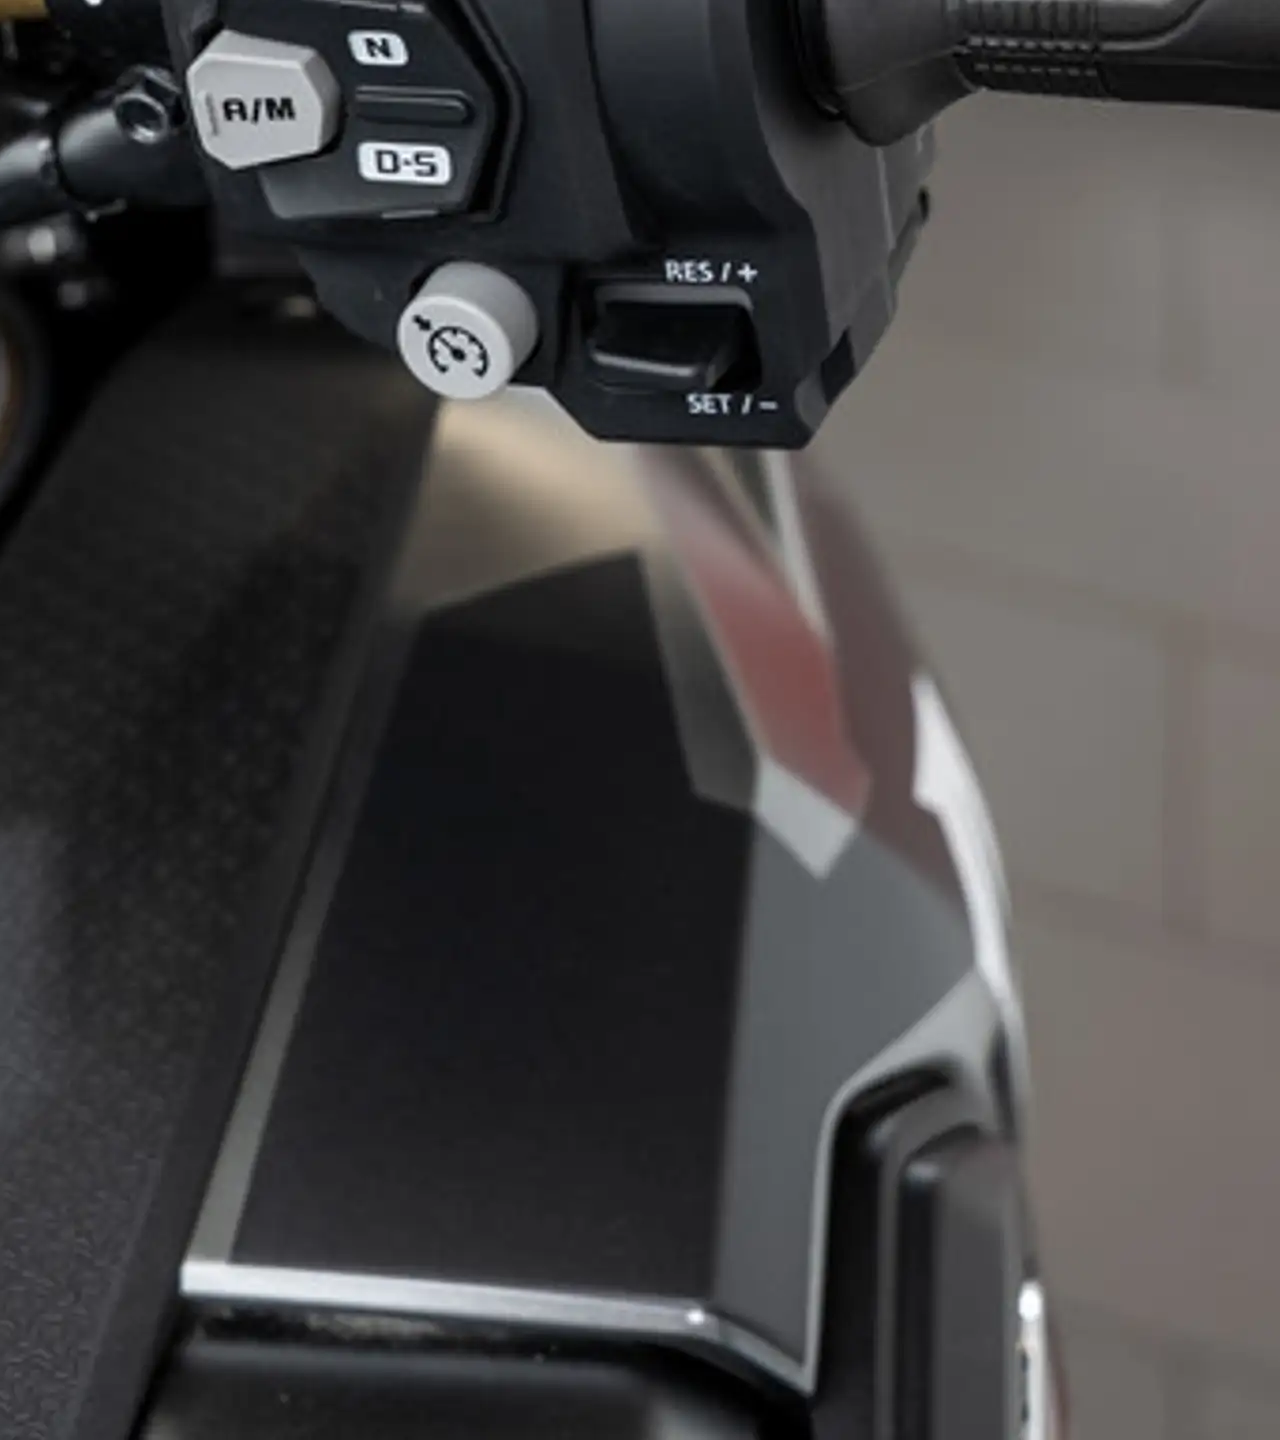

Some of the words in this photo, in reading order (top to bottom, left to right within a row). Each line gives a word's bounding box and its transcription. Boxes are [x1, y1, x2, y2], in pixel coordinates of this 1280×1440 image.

[364, 36, 392, 59] N
[222, 96, 296, 124] A/M
[374, 148, 439, 177] D-S
[665, 259, 715, 283] RES
[686, 392, 732, 415] SET
